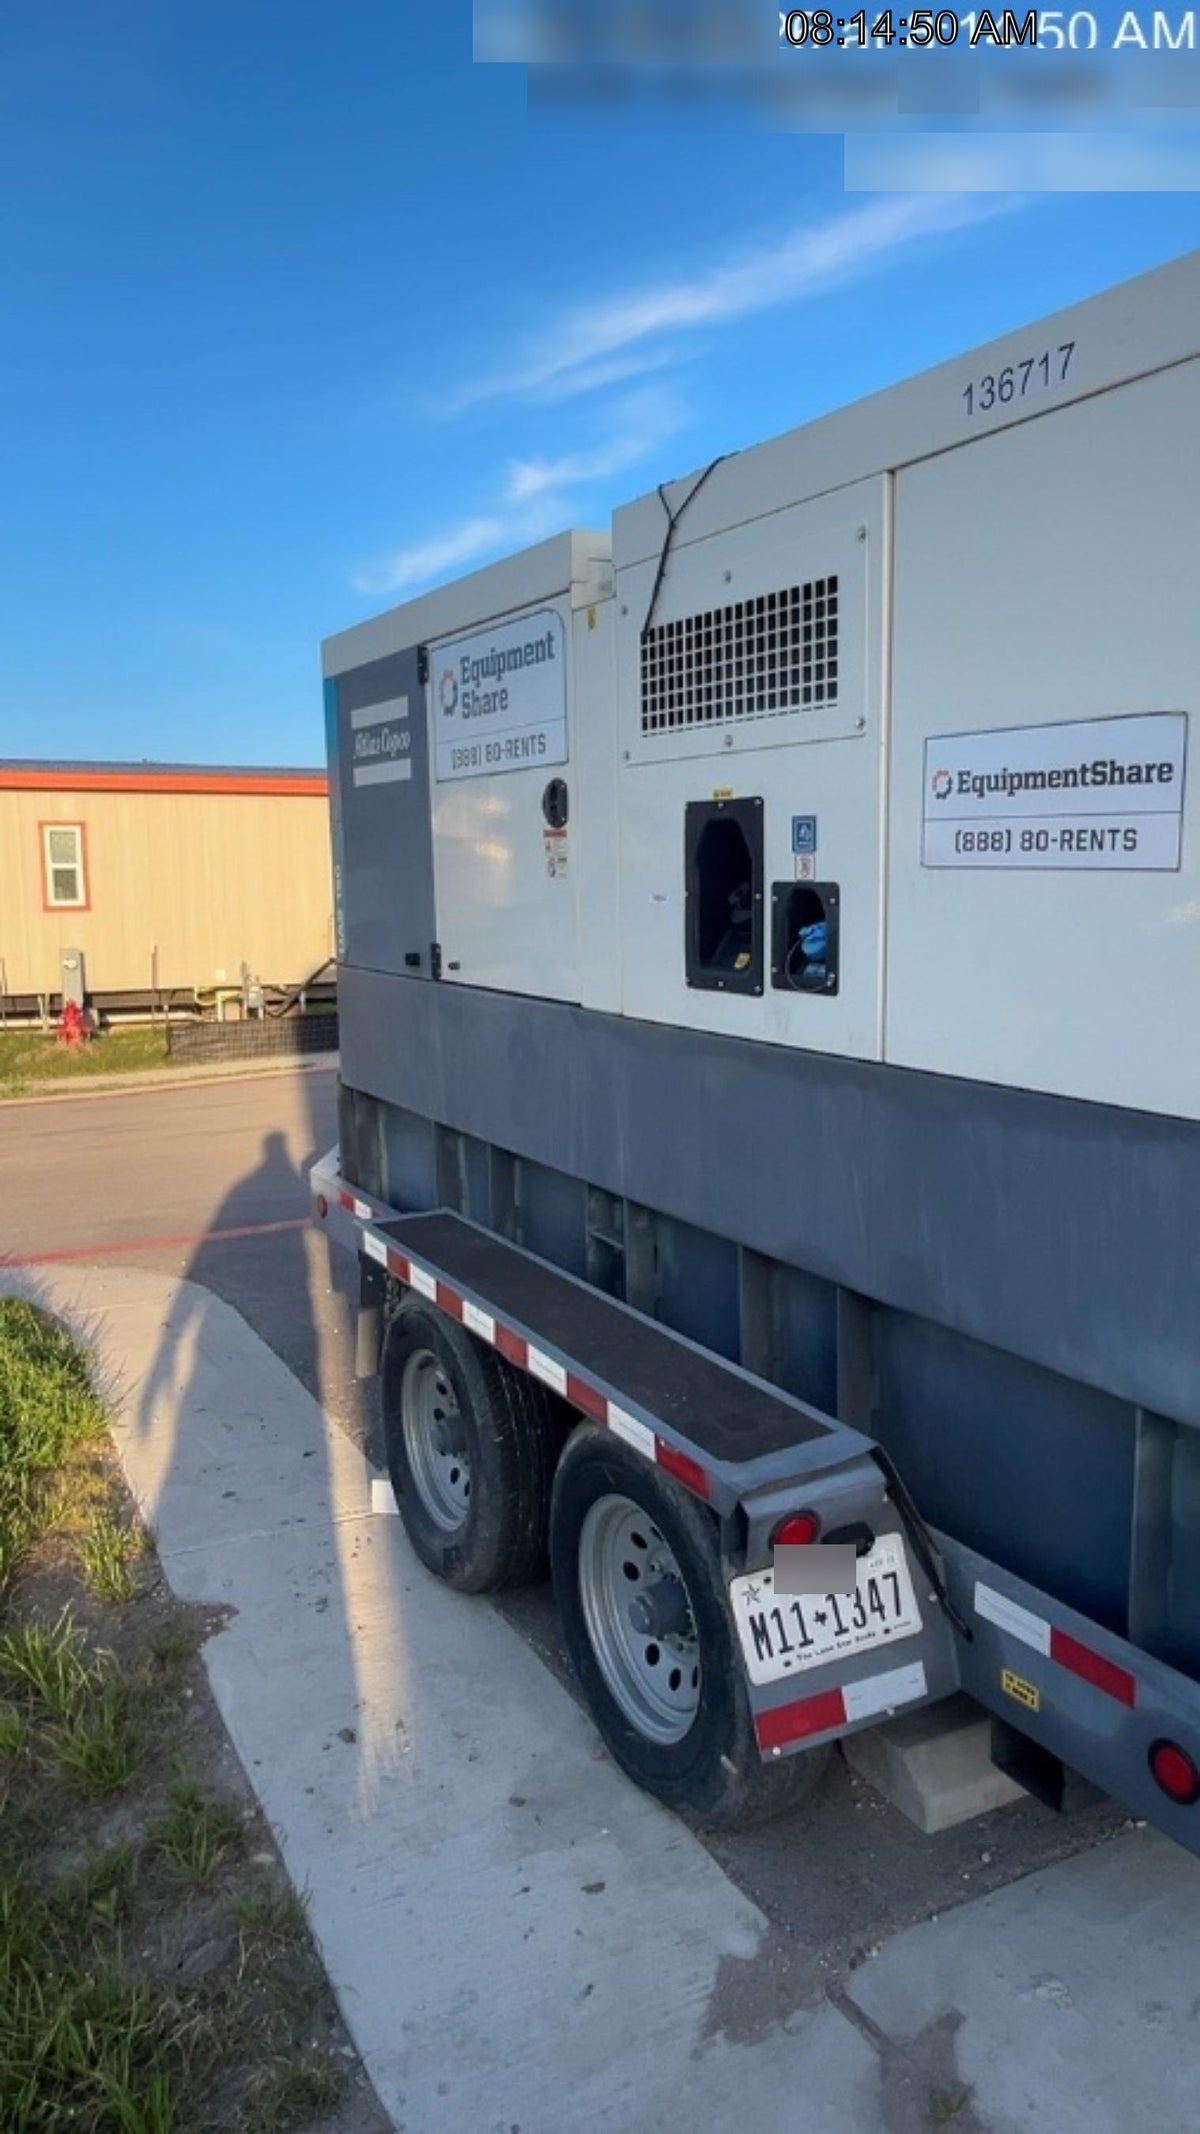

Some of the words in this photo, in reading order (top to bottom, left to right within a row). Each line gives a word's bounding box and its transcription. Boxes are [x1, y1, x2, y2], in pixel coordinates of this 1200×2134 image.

[963, 341, 1075, 416] 136717
[459, 631, 555, 685] Equipment
[462, 687, 508, 719] Share
[957, 760, 1174, 798] EquipmentShare
[955, 829, 1011, 854] (888)
[1020, 828, 1138, 852] 80-RENTS
